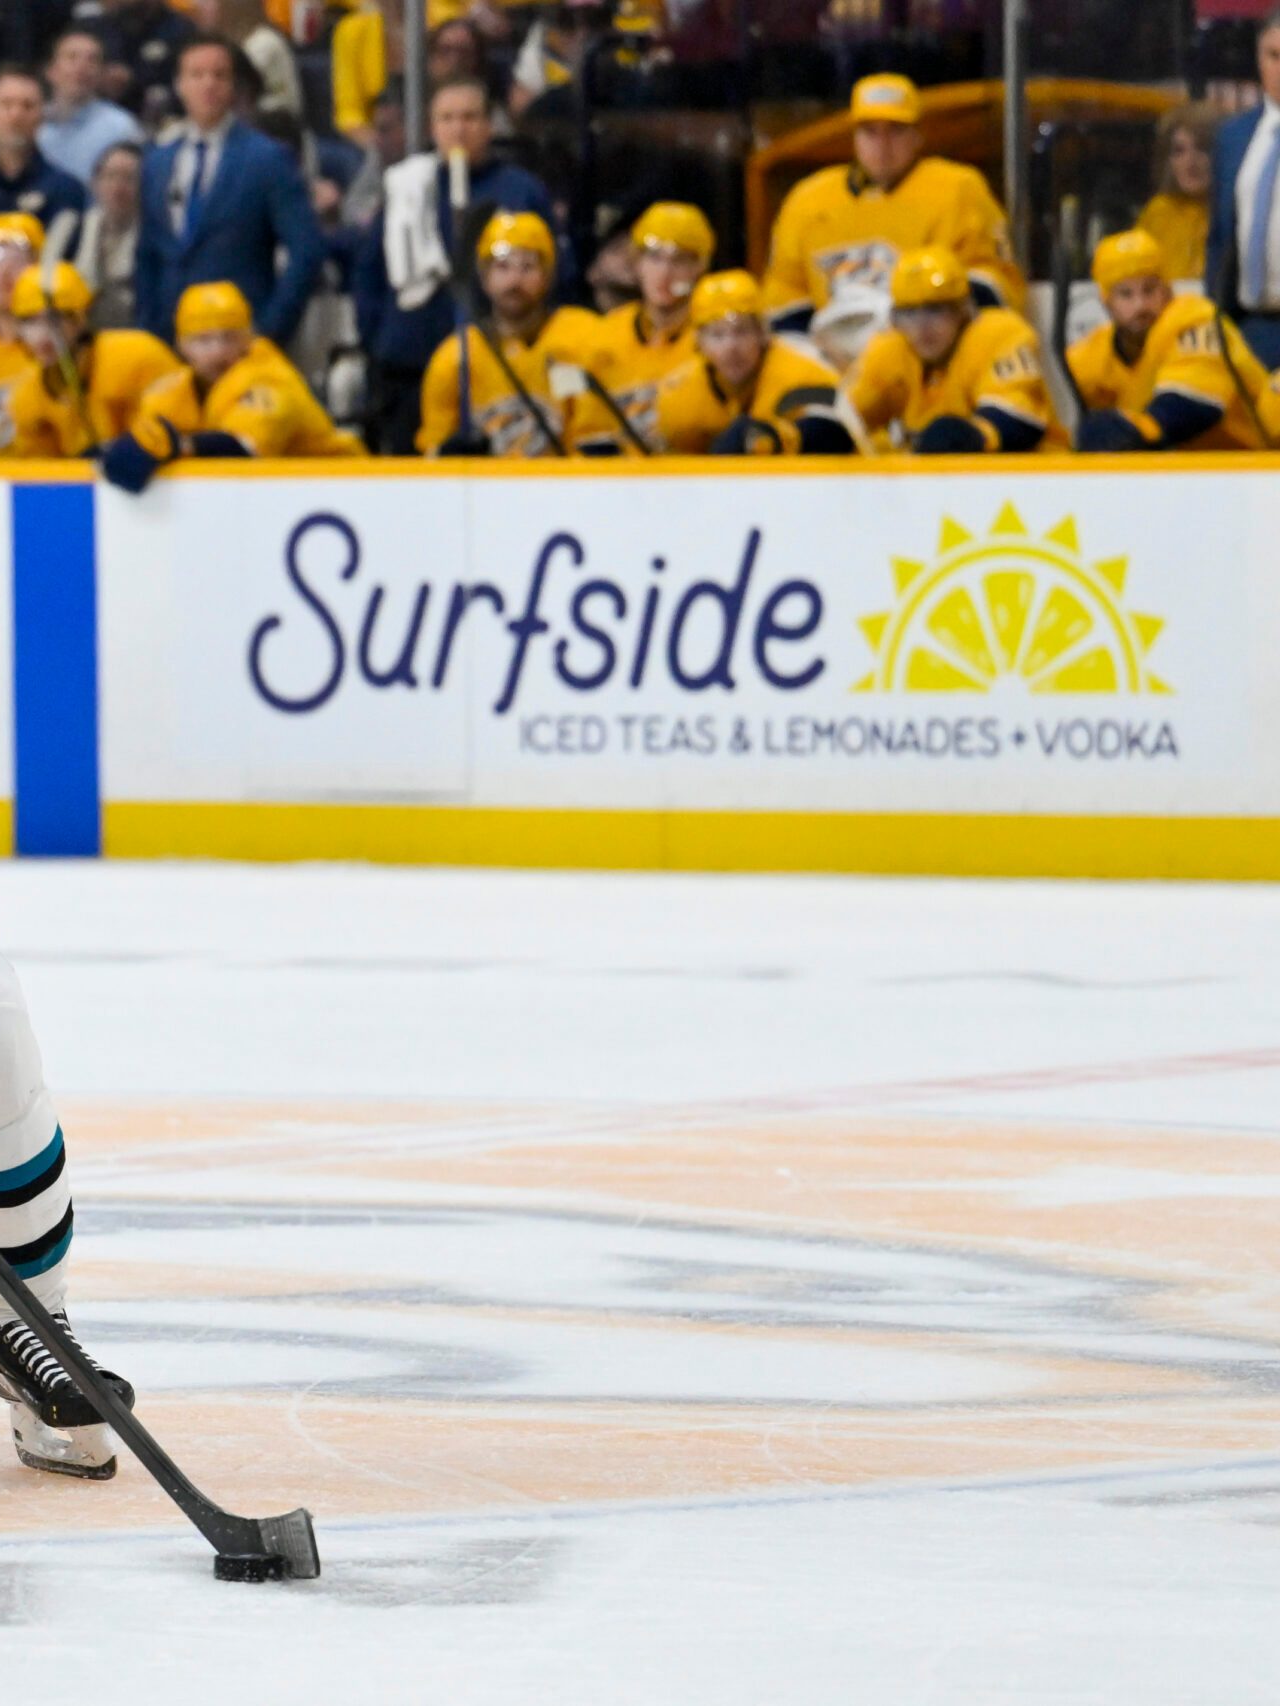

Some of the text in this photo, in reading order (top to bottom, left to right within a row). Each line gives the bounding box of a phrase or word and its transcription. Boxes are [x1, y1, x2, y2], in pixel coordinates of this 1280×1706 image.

[246, 510, 827, 716] Surfside
[519, 715, 608, 754] ICED
[618, 714, 718, 755] TEAS
[729, 716, 753, 754] &
[764, 716, 1002, 758] LEMONADES
[1034, 718, 1180, 760] VODKA
